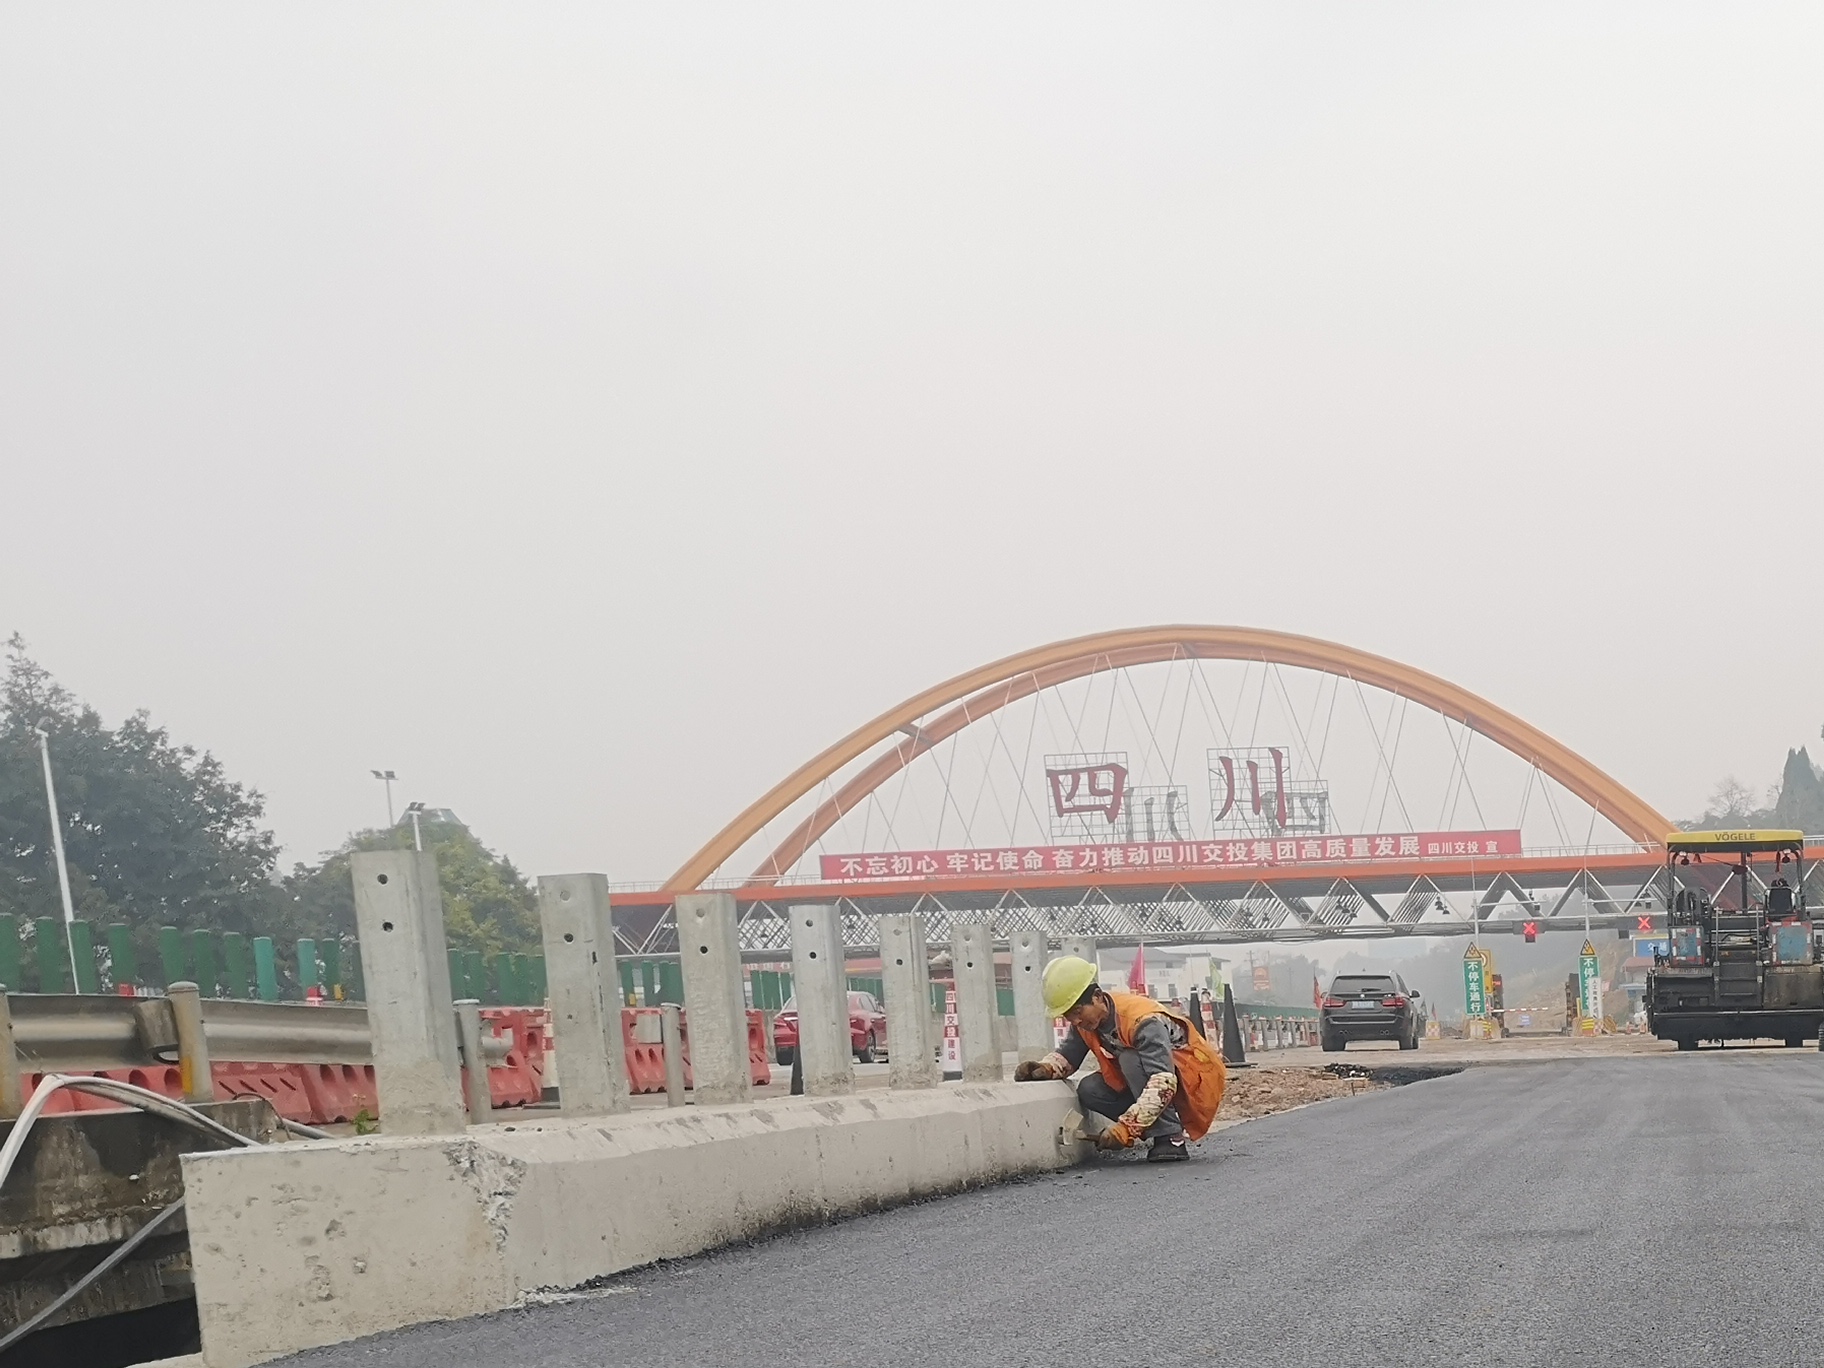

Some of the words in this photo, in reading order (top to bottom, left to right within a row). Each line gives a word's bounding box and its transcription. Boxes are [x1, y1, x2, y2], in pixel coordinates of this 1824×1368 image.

[1046, 747, 1288, 828] 四川
[840, 854, 939, 877] 不忘初心
[946, 850, 1045, 872] 牢记使命
[1051, 836, 1420, 869] 奋力推动四川交投集团高质量发展
[1428, 841, 1479, 854] 四川交投
[1485, 840, 1498, 853] 宣
[1714, 831, 1756, 841] VÖGELE
[1467, 961, 1481, 1012] 不停车通行
[945, 992, 957, 1060] 四川交投建设
